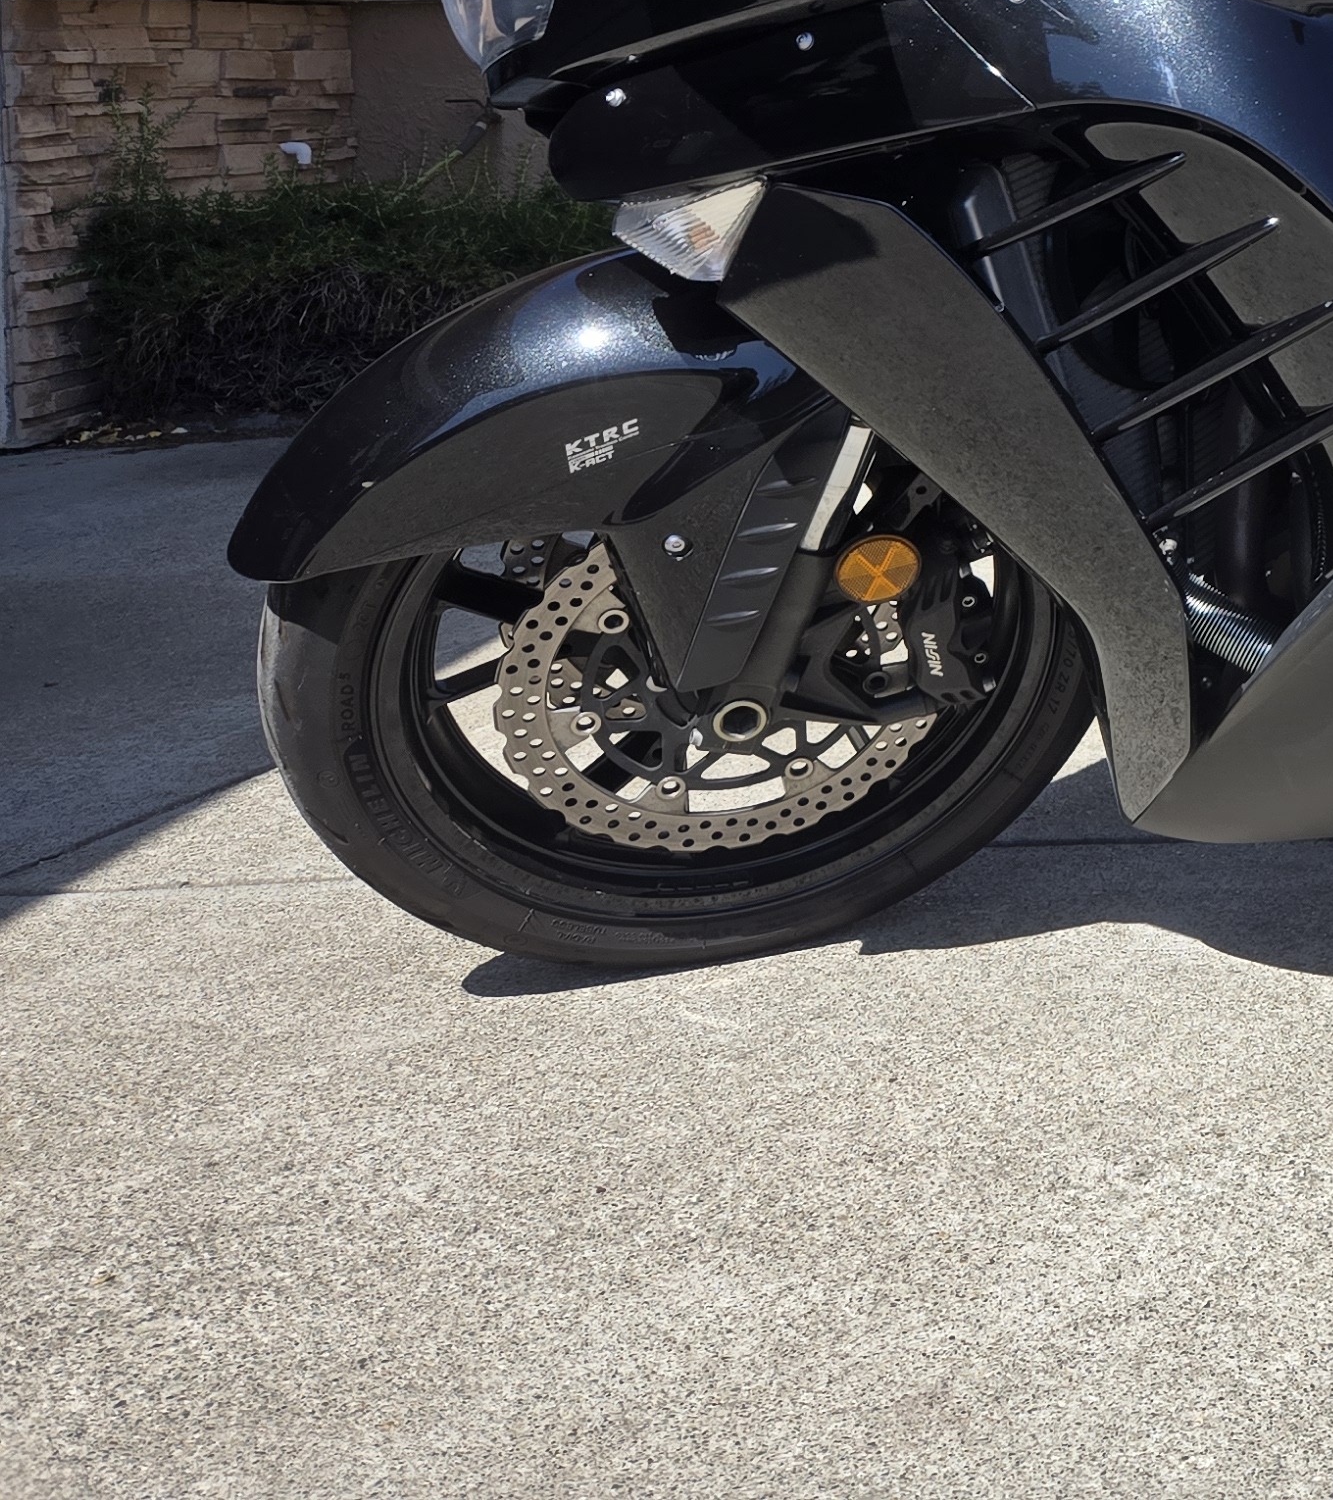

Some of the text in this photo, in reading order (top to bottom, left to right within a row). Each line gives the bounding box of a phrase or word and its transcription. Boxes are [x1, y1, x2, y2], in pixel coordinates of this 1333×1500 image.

[564, 417, 639, 457] KTRC
[567, 449, 616, 475] K-ACT
[920, 630, 945, 679] NISSIN
[340, 684, 356, 732] ROAD
[349, 753, 444, 875] MICHELIN
